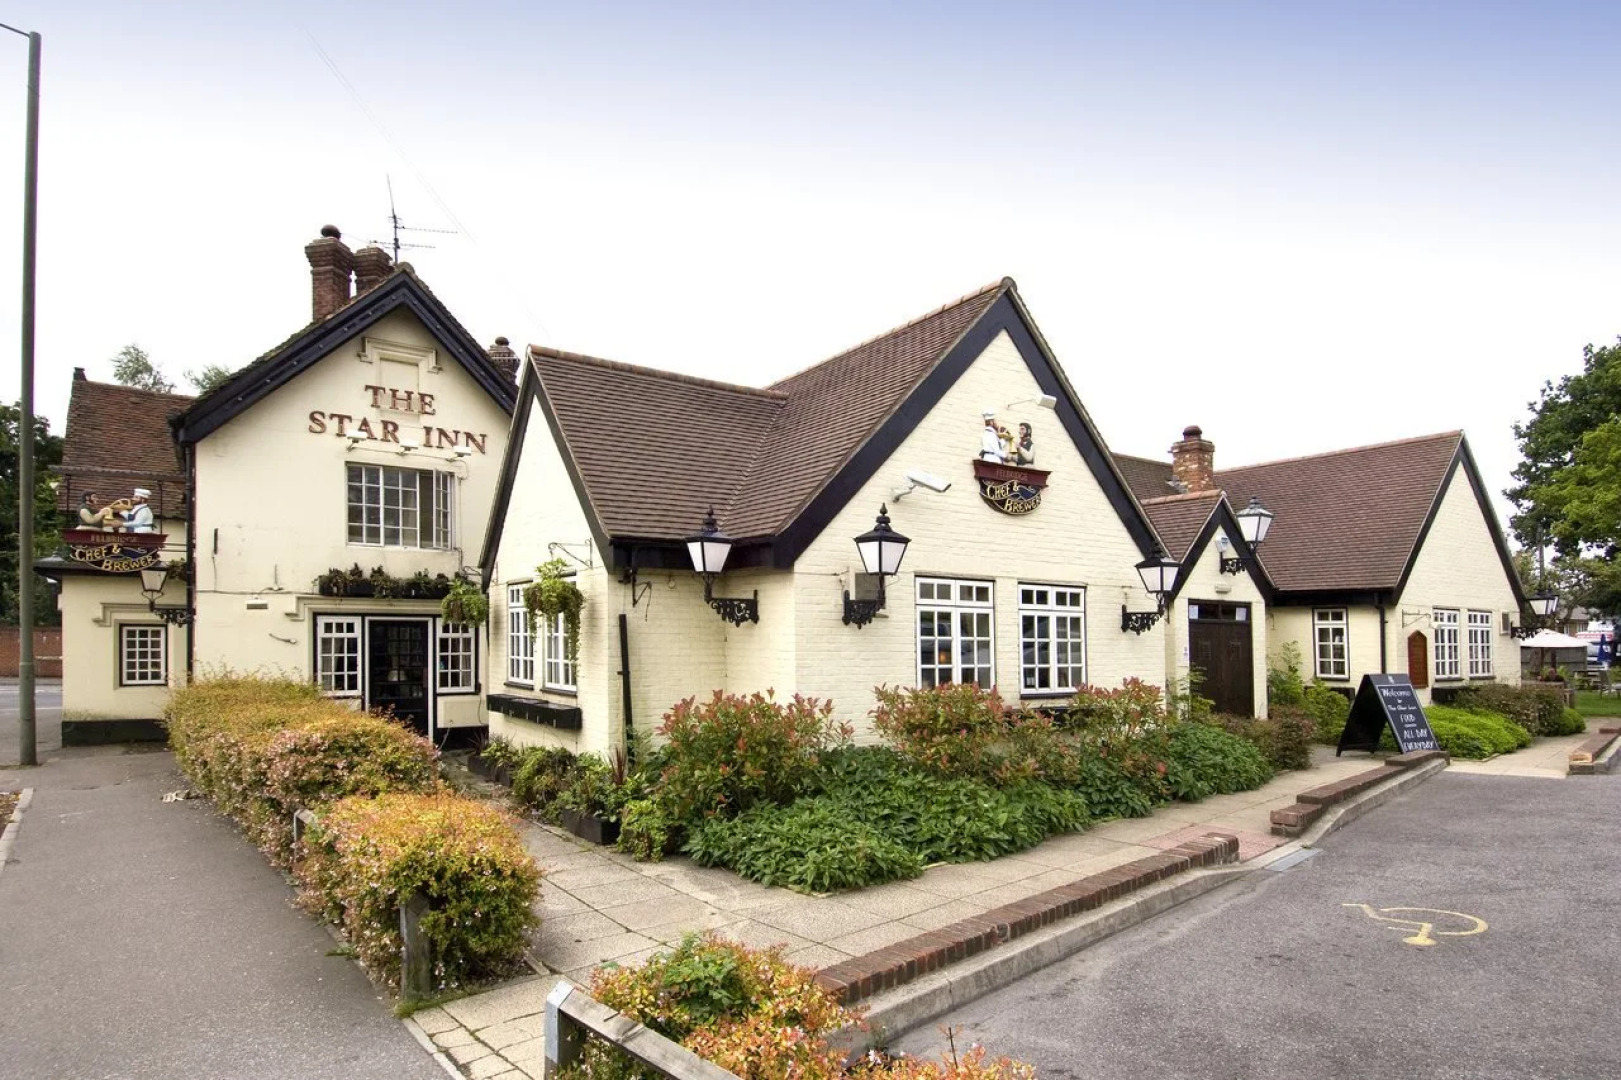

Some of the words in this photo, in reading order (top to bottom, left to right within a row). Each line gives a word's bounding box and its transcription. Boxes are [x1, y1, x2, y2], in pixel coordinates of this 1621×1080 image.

[365, 385, 436, 416] THE
[308, 410, 400, 444] STAR
[423, 426, 487, 455] INN
[1013, 481, 1019, 492] &
[112, 543, 121, 554] &
